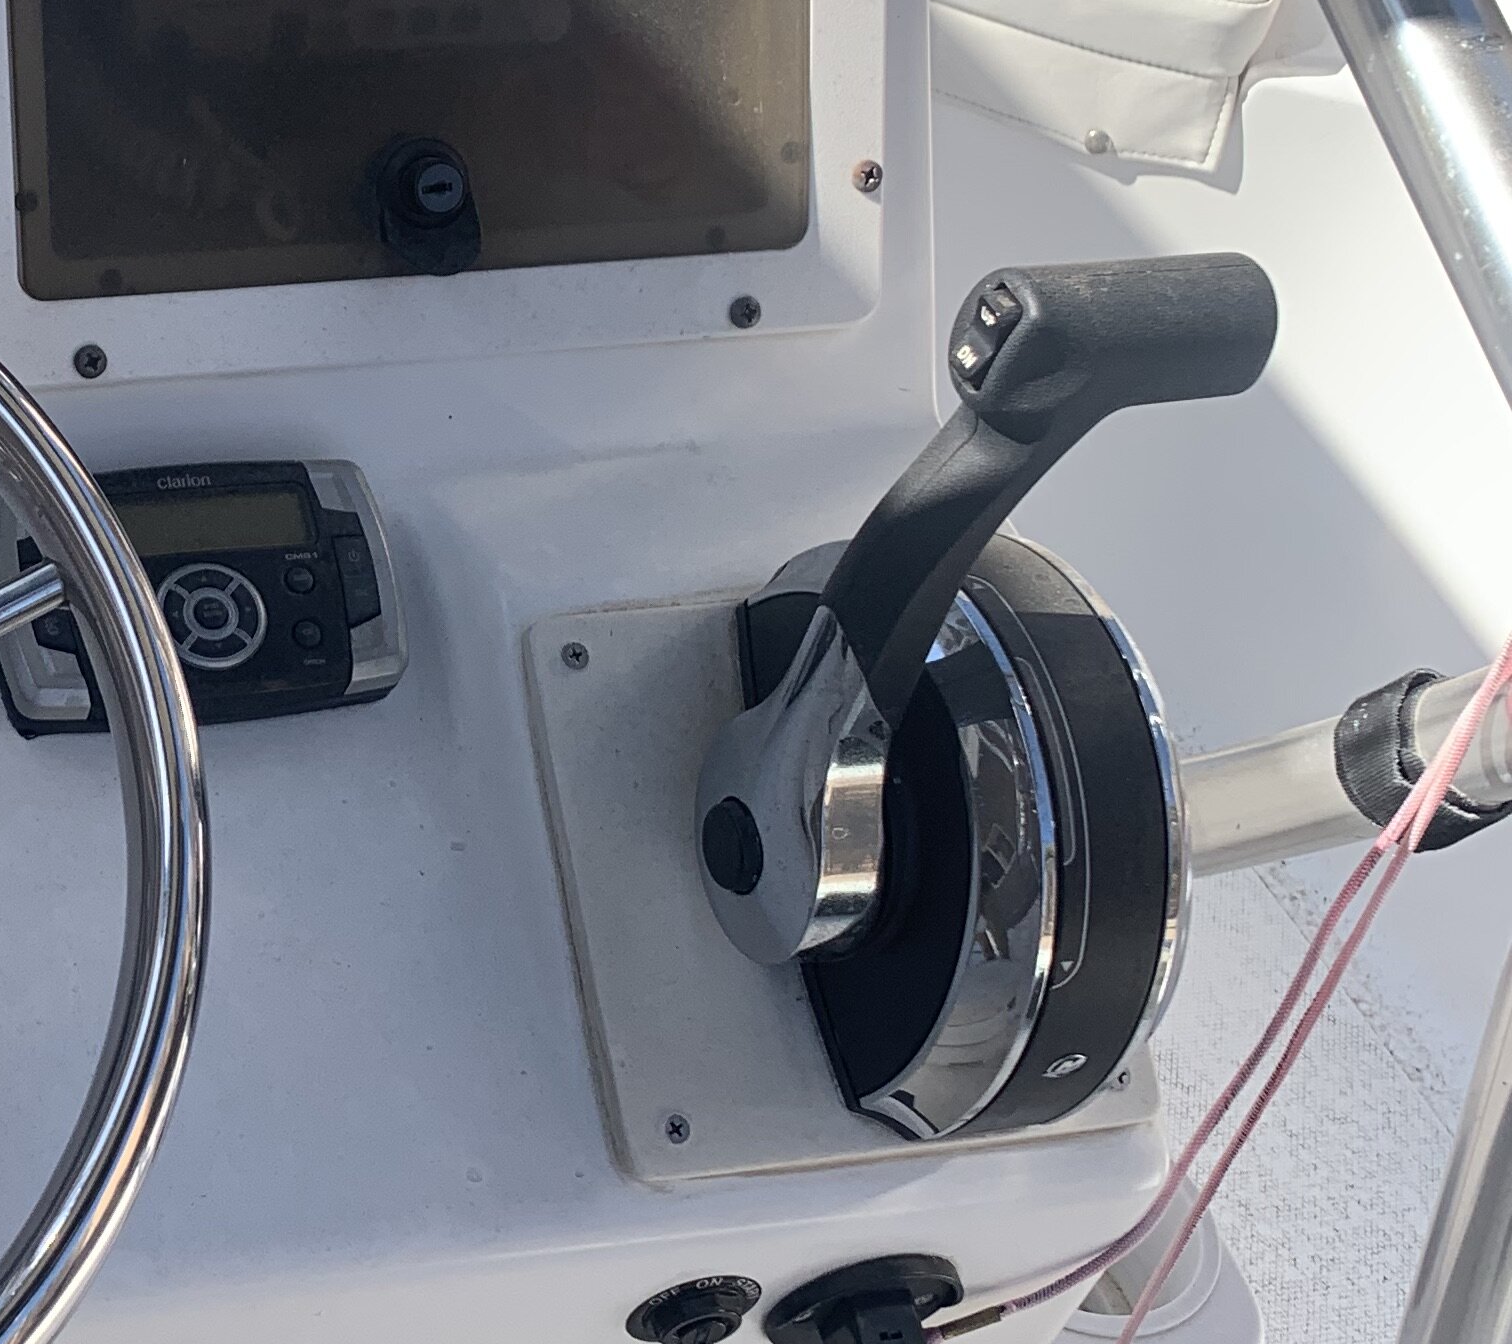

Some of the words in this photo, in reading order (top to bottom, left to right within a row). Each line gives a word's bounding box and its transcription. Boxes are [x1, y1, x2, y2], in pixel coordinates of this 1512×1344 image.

[157, 474, 212, 490] clarion
[648, 1287, 680, 1306] OFF
[695, 1277, 723, 1289] ON
